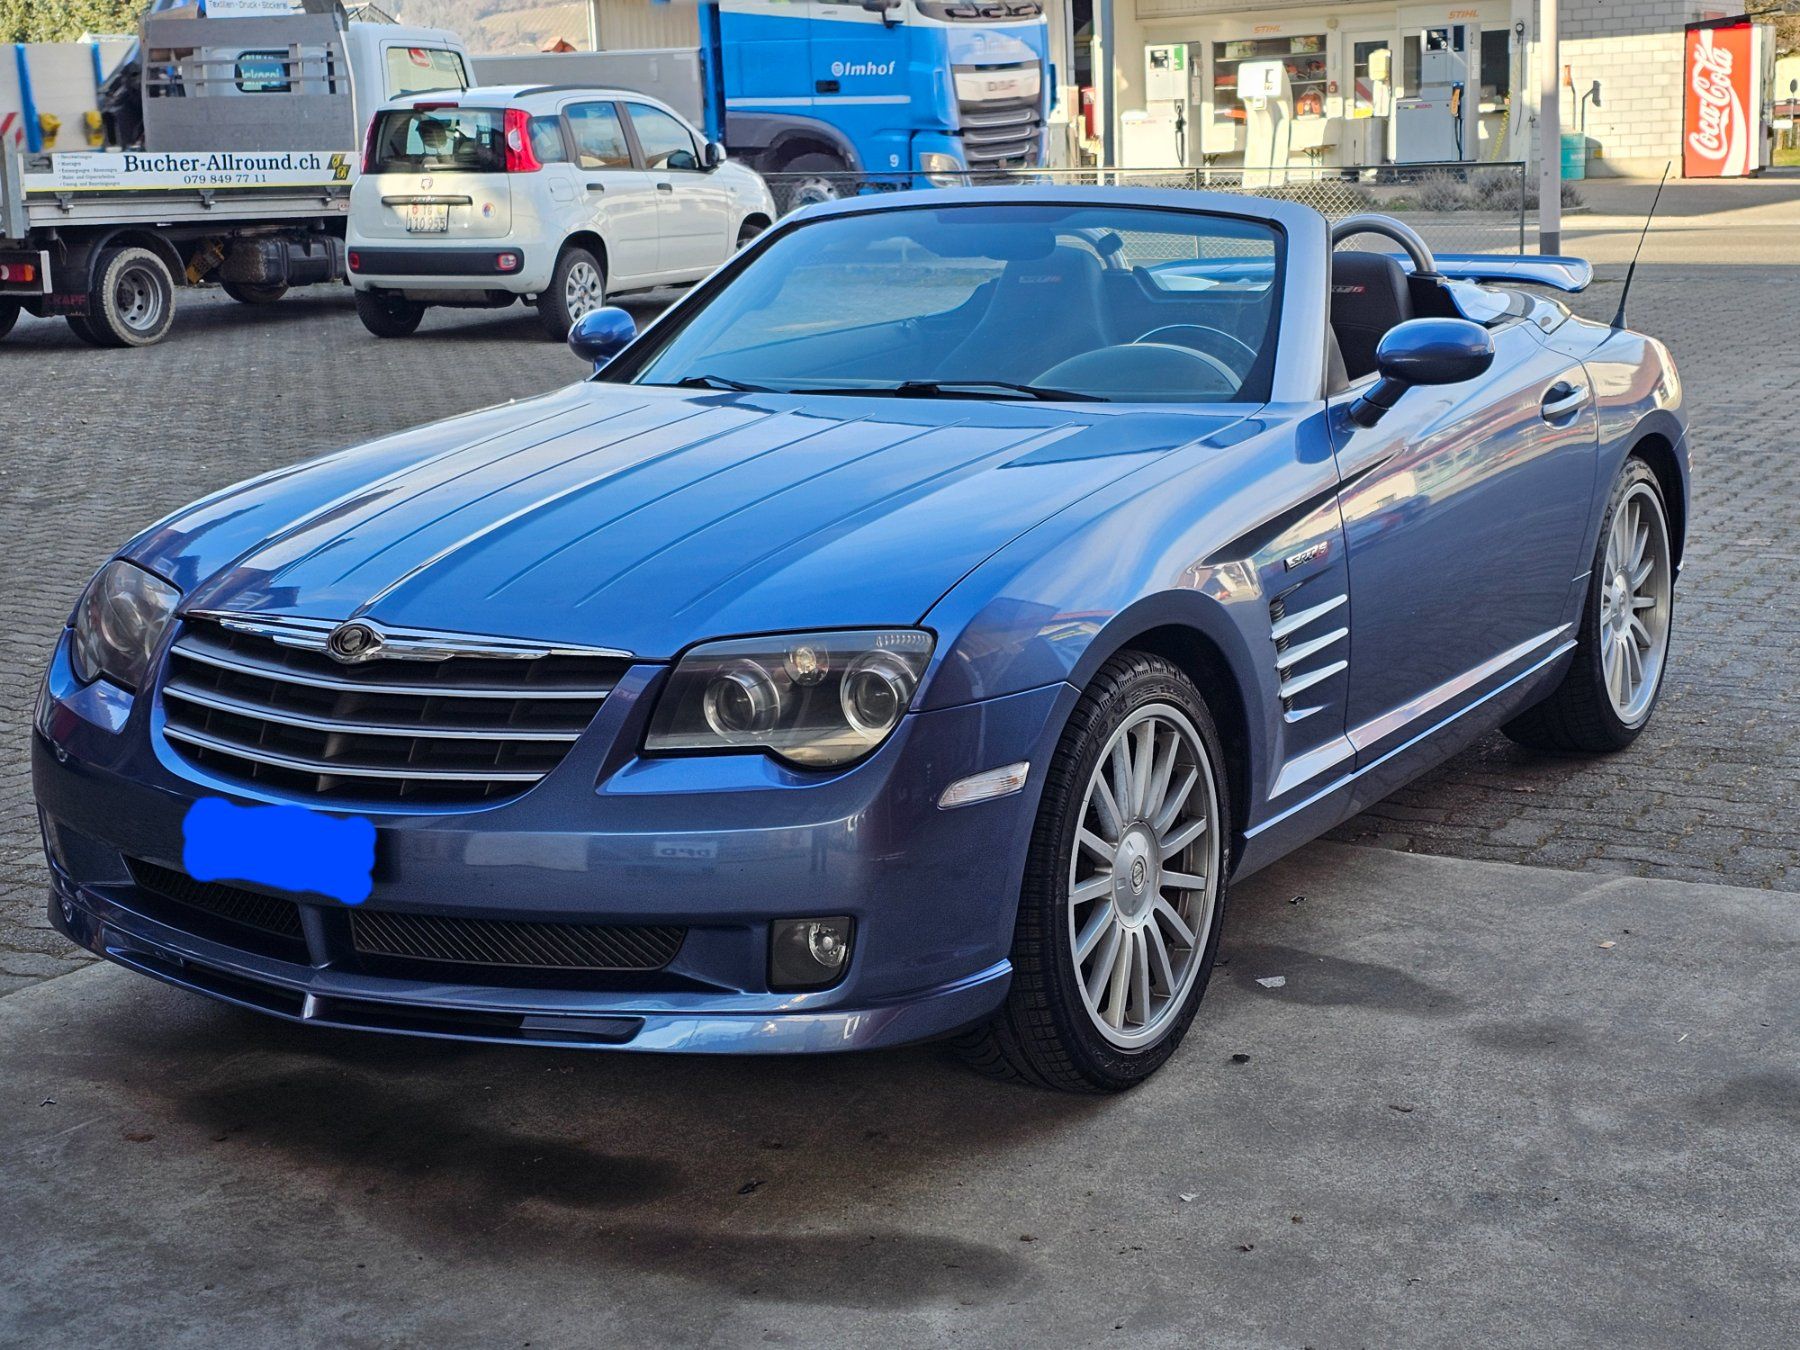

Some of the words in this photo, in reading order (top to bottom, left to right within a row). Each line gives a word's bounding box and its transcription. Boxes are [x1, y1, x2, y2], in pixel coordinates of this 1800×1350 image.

[1448, 9, 1479, 19] STIHL
[1253, 25, 1281, 33] STIHL
[844, 61, 896, 76] Imhof
[124, 153, 321, 173] Bucher-Allround.ch
[889, 154, 899, 167] 9
[184, 175, 206, 184] 079
[210, 174, 232, 184] 849
[235, 174, 250, 183] 77
[254, 174, 267, 183] 11
